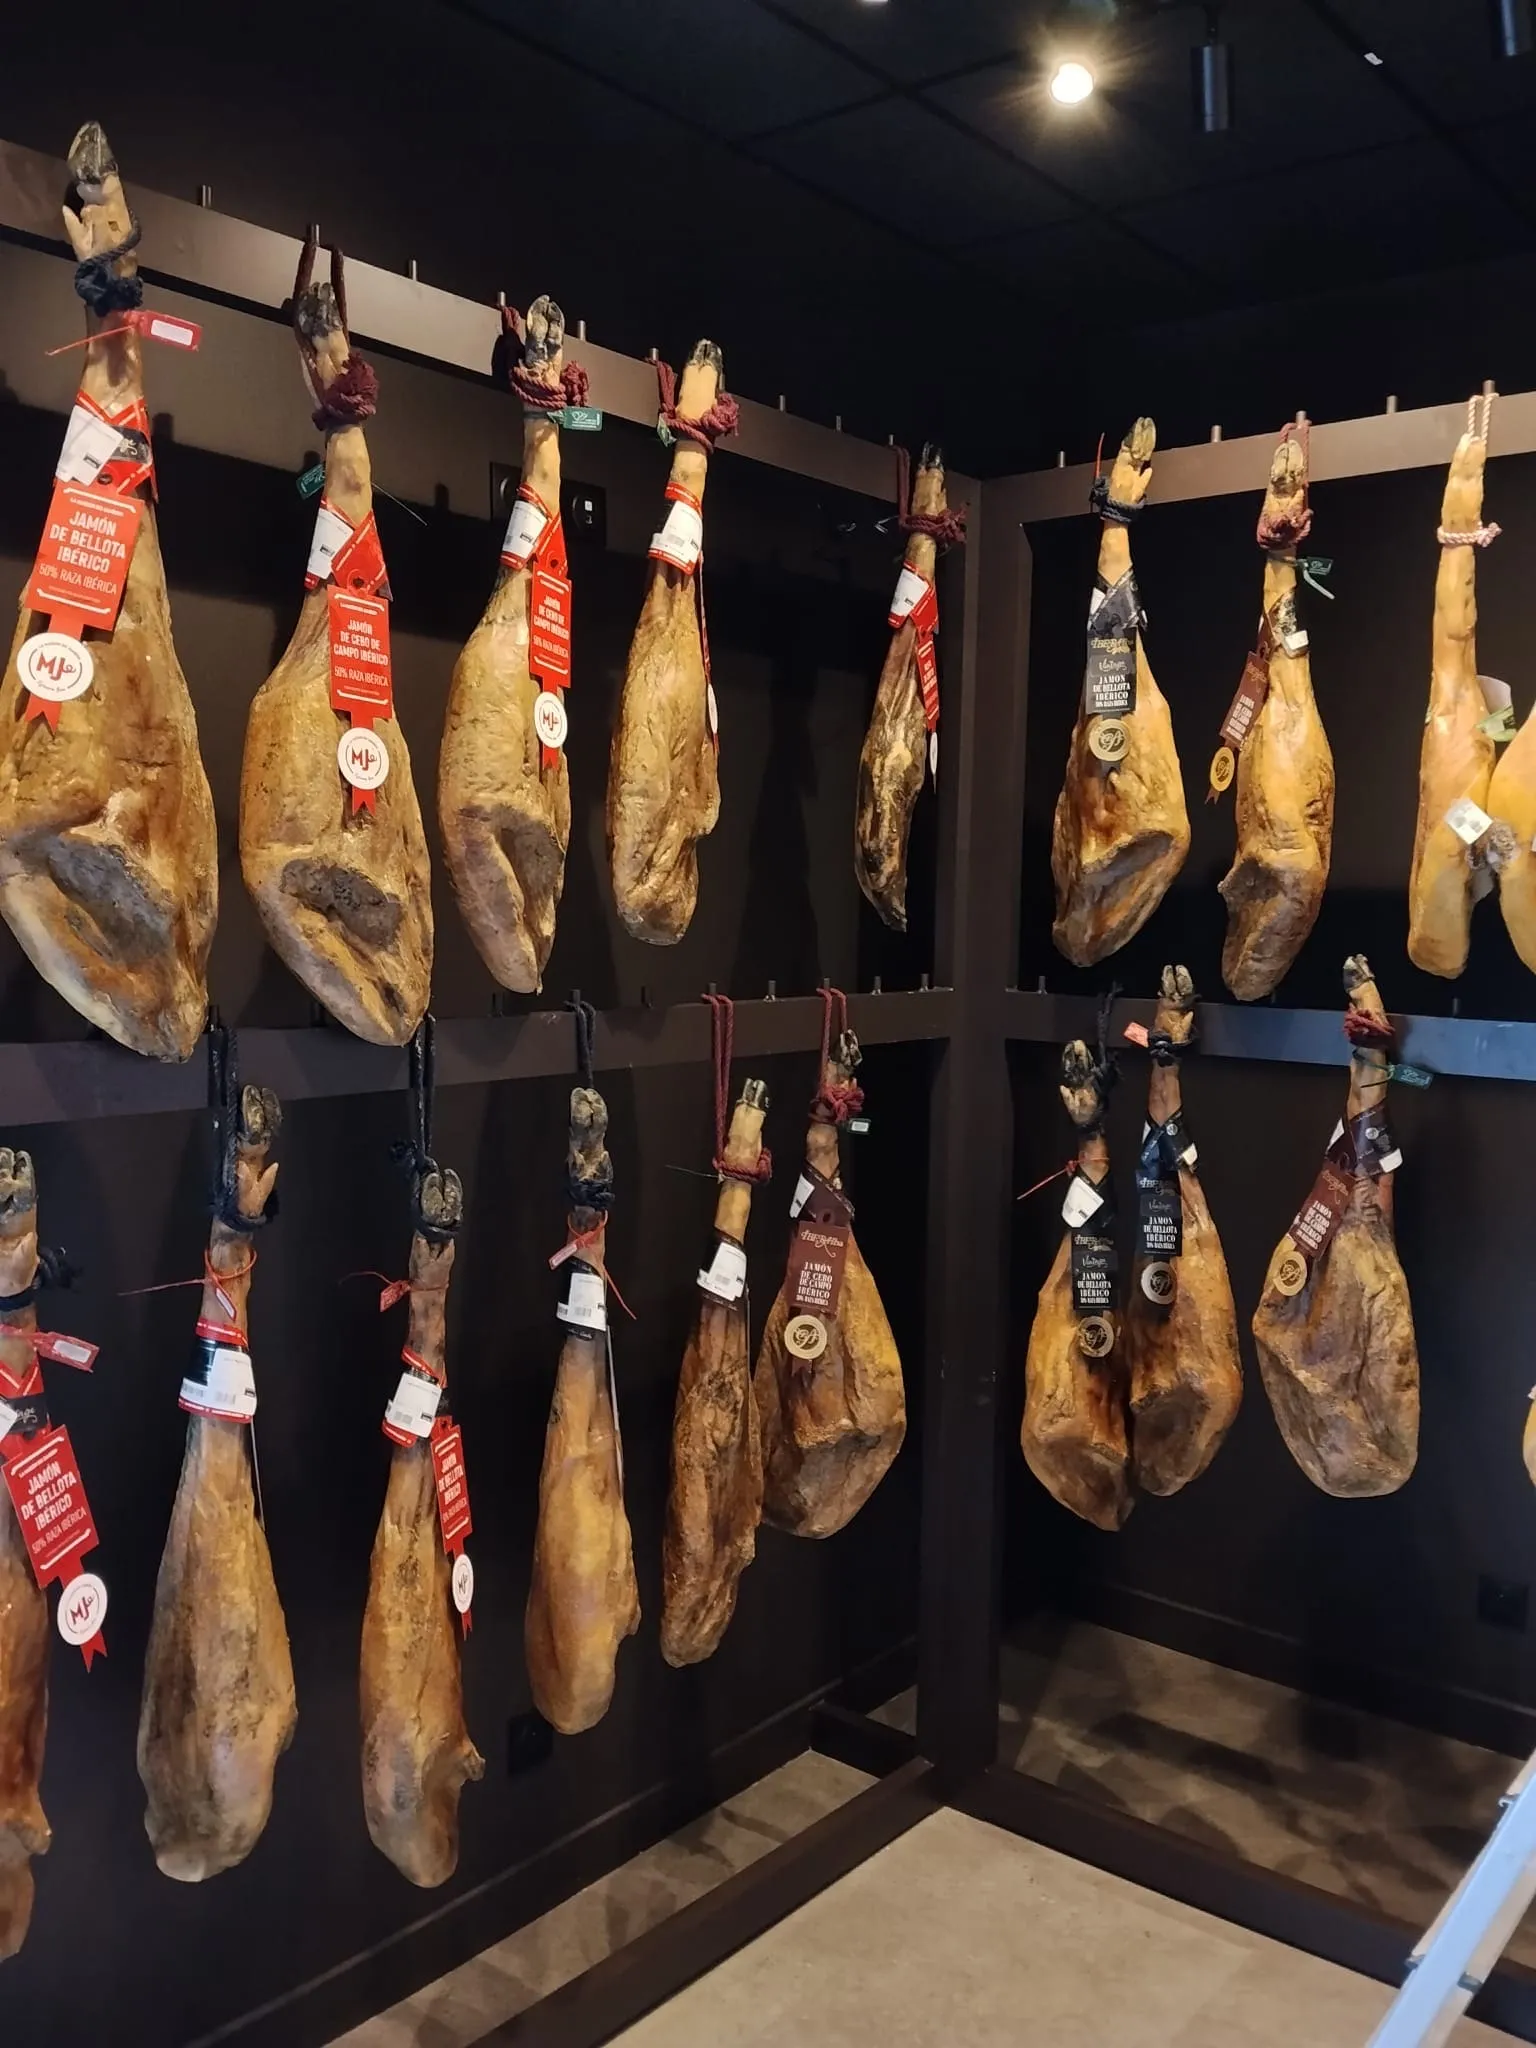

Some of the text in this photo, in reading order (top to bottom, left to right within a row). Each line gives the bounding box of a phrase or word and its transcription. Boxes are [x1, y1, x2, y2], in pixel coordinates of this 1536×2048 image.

[69, 511, 117, 537] JAMÓN
[50, 524, 126, 559] DE BELLOTA
[57, 546, 110, 574] IBÉRICO
[39, 563, 58, 579] 50%
[60, 568, 81, 585] RAZA
[83, 575, 117, 595] IBÉRICA
[333, 644, 360, 660] CAMPO
[340, 631, 380, 651] DE CEBO DE
[801, 1270, 811, 1280] DE
[28, 1461, 61, 1495] JAMÓN
[21, 1471, 77, 1520] DE BELLOTA
[35, 1493, 72, 1531] IBÉRICO
[45, 1524, 62, 1543] RAZA
[61, 1506, 87, 1532] IBÉRICA
